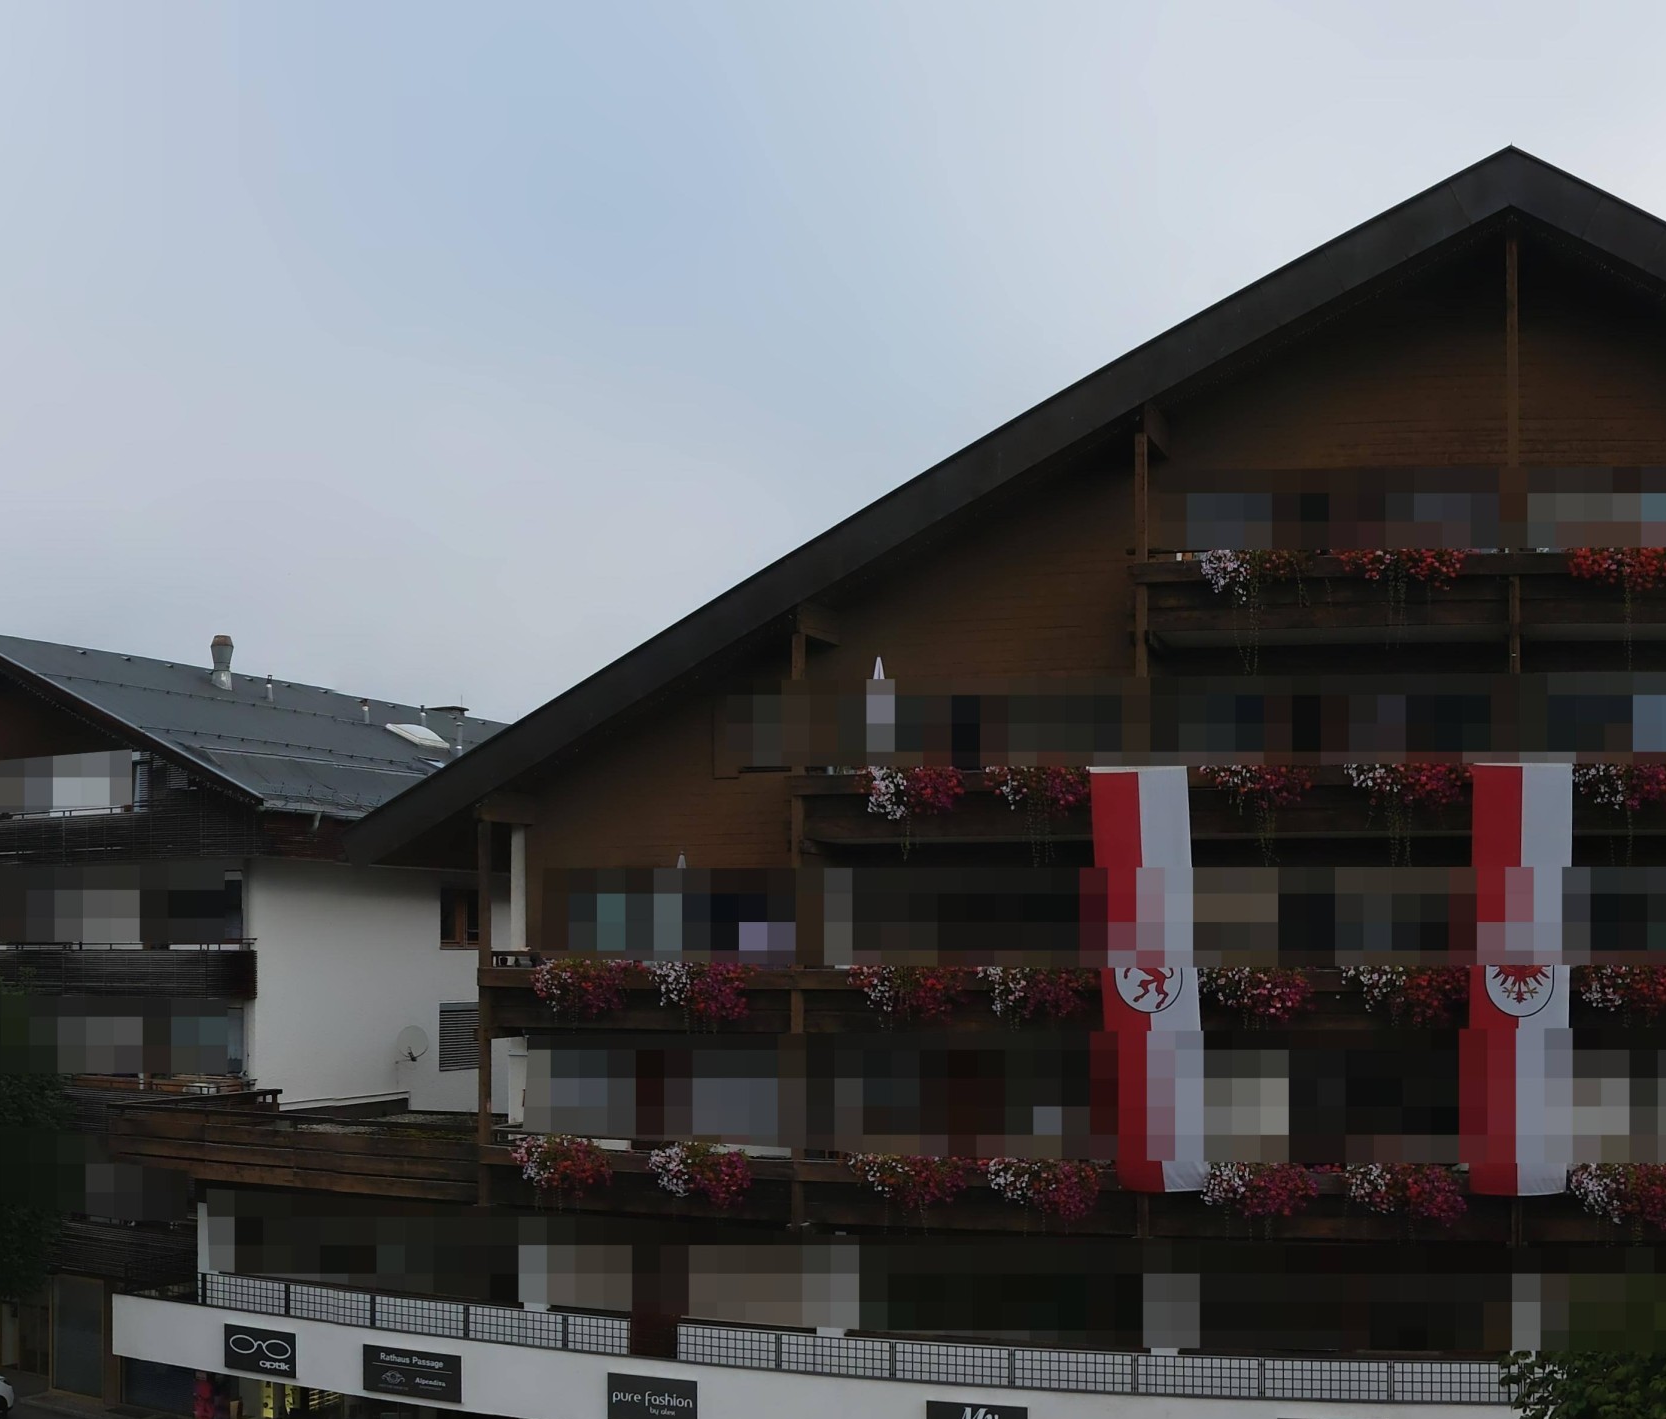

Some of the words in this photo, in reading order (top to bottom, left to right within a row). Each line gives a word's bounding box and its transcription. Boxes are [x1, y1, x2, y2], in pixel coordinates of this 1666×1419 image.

[259, 1360, 290, 1371] optik
[379, 1352, 411, 1364] Rathaus
[412, 1356, 445, 1369] Passage
[612, 1391, 642, 1404] pure
[645, 1391, 693, 1409] fashion
[649, 1406, 660, 1416] by
